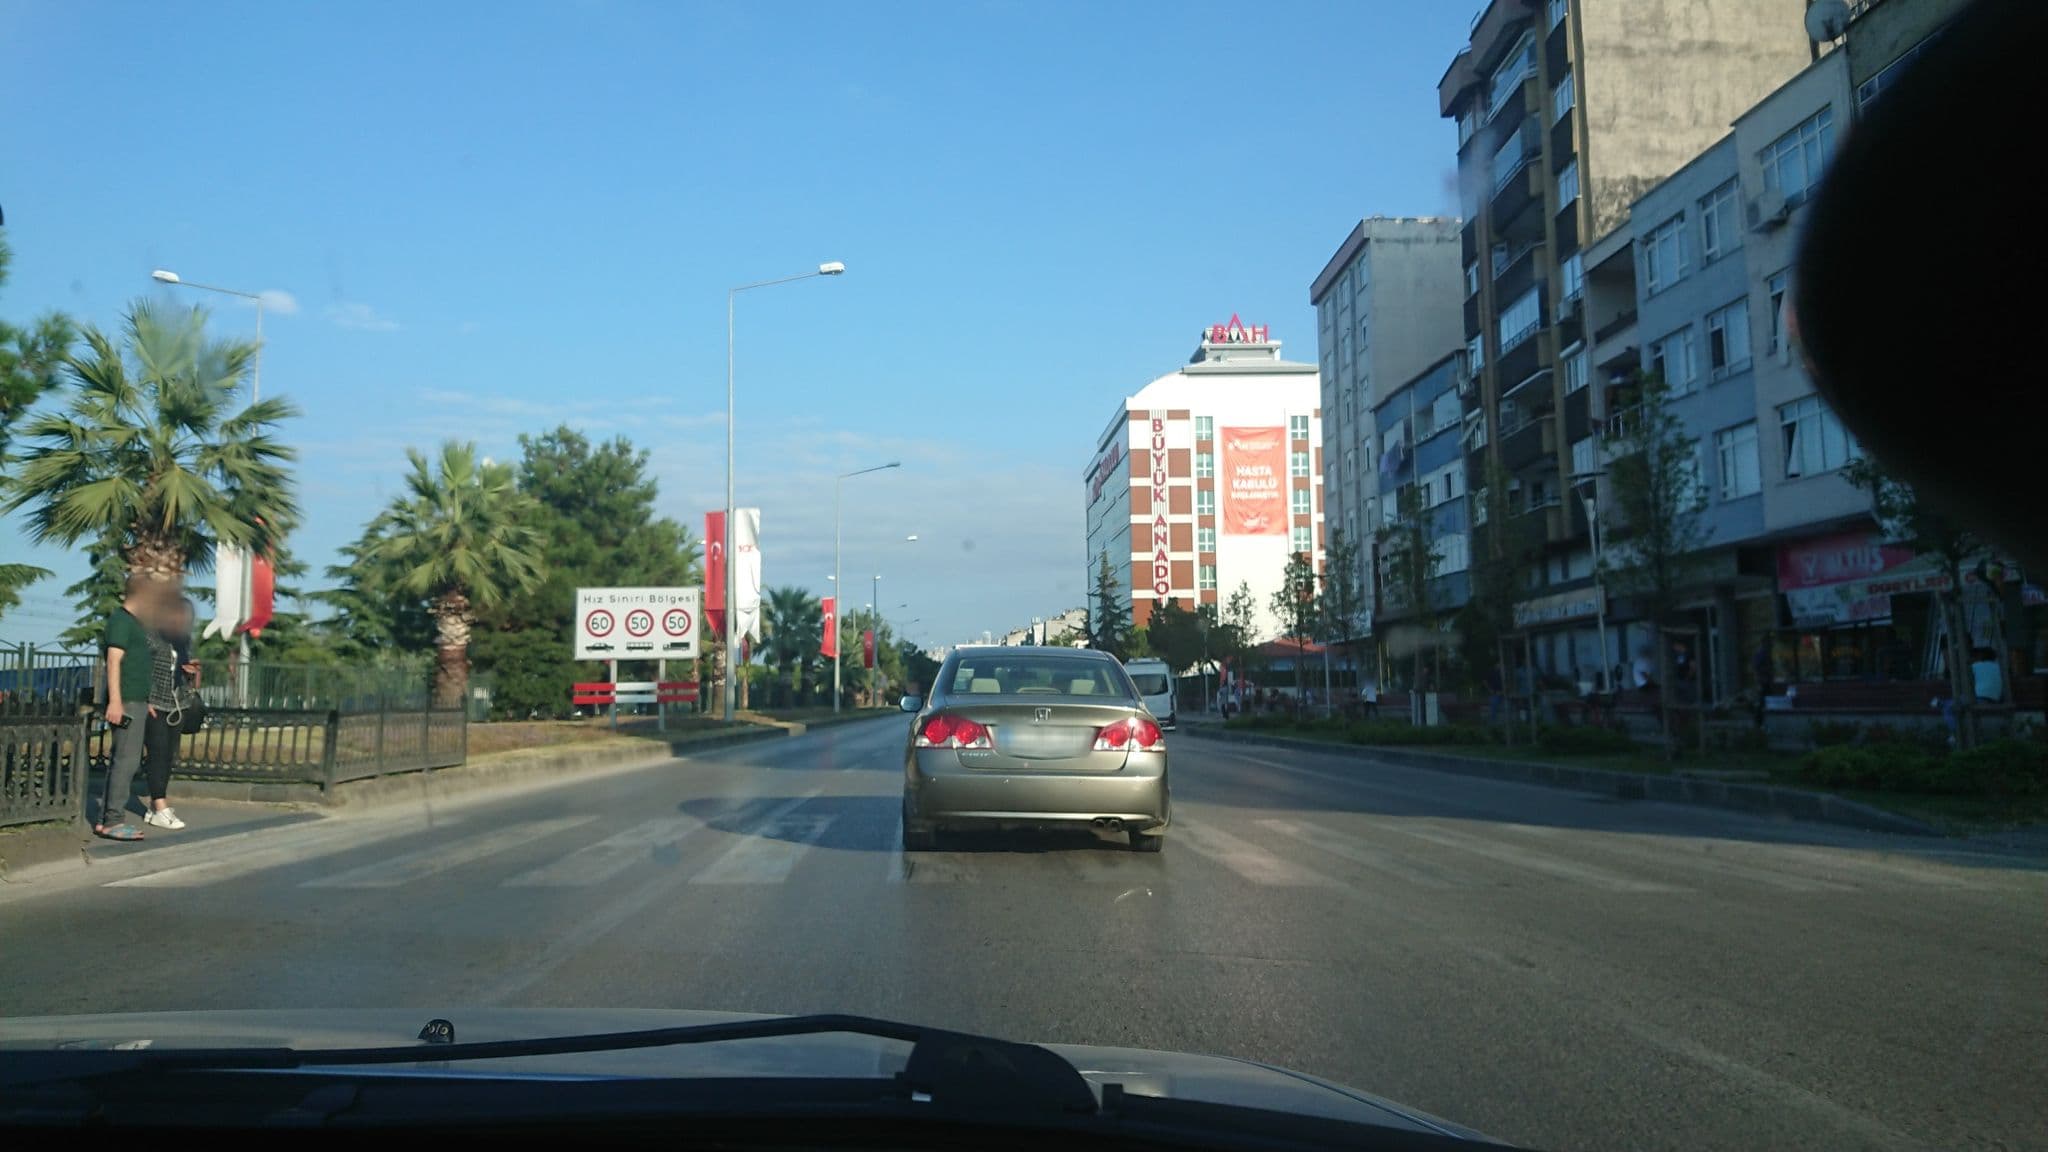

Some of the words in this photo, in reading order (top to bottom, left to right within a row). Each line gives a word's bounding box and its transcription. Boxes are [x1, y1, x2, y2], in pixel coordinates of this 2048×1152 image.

[1212, 312, 1268, 344] BAH
[1152, 418, 1166, 502] BÜYÜK
[1236, 466, 1272, 476] HASTA
[1233, 477, 1278, 489] KABULÜ
[649, 594, 695, 605] Bölgesi
[591, 616, 609, 630] 60
[631, 616, 649, 630] 50
[668, 616, 686, 629] 50
